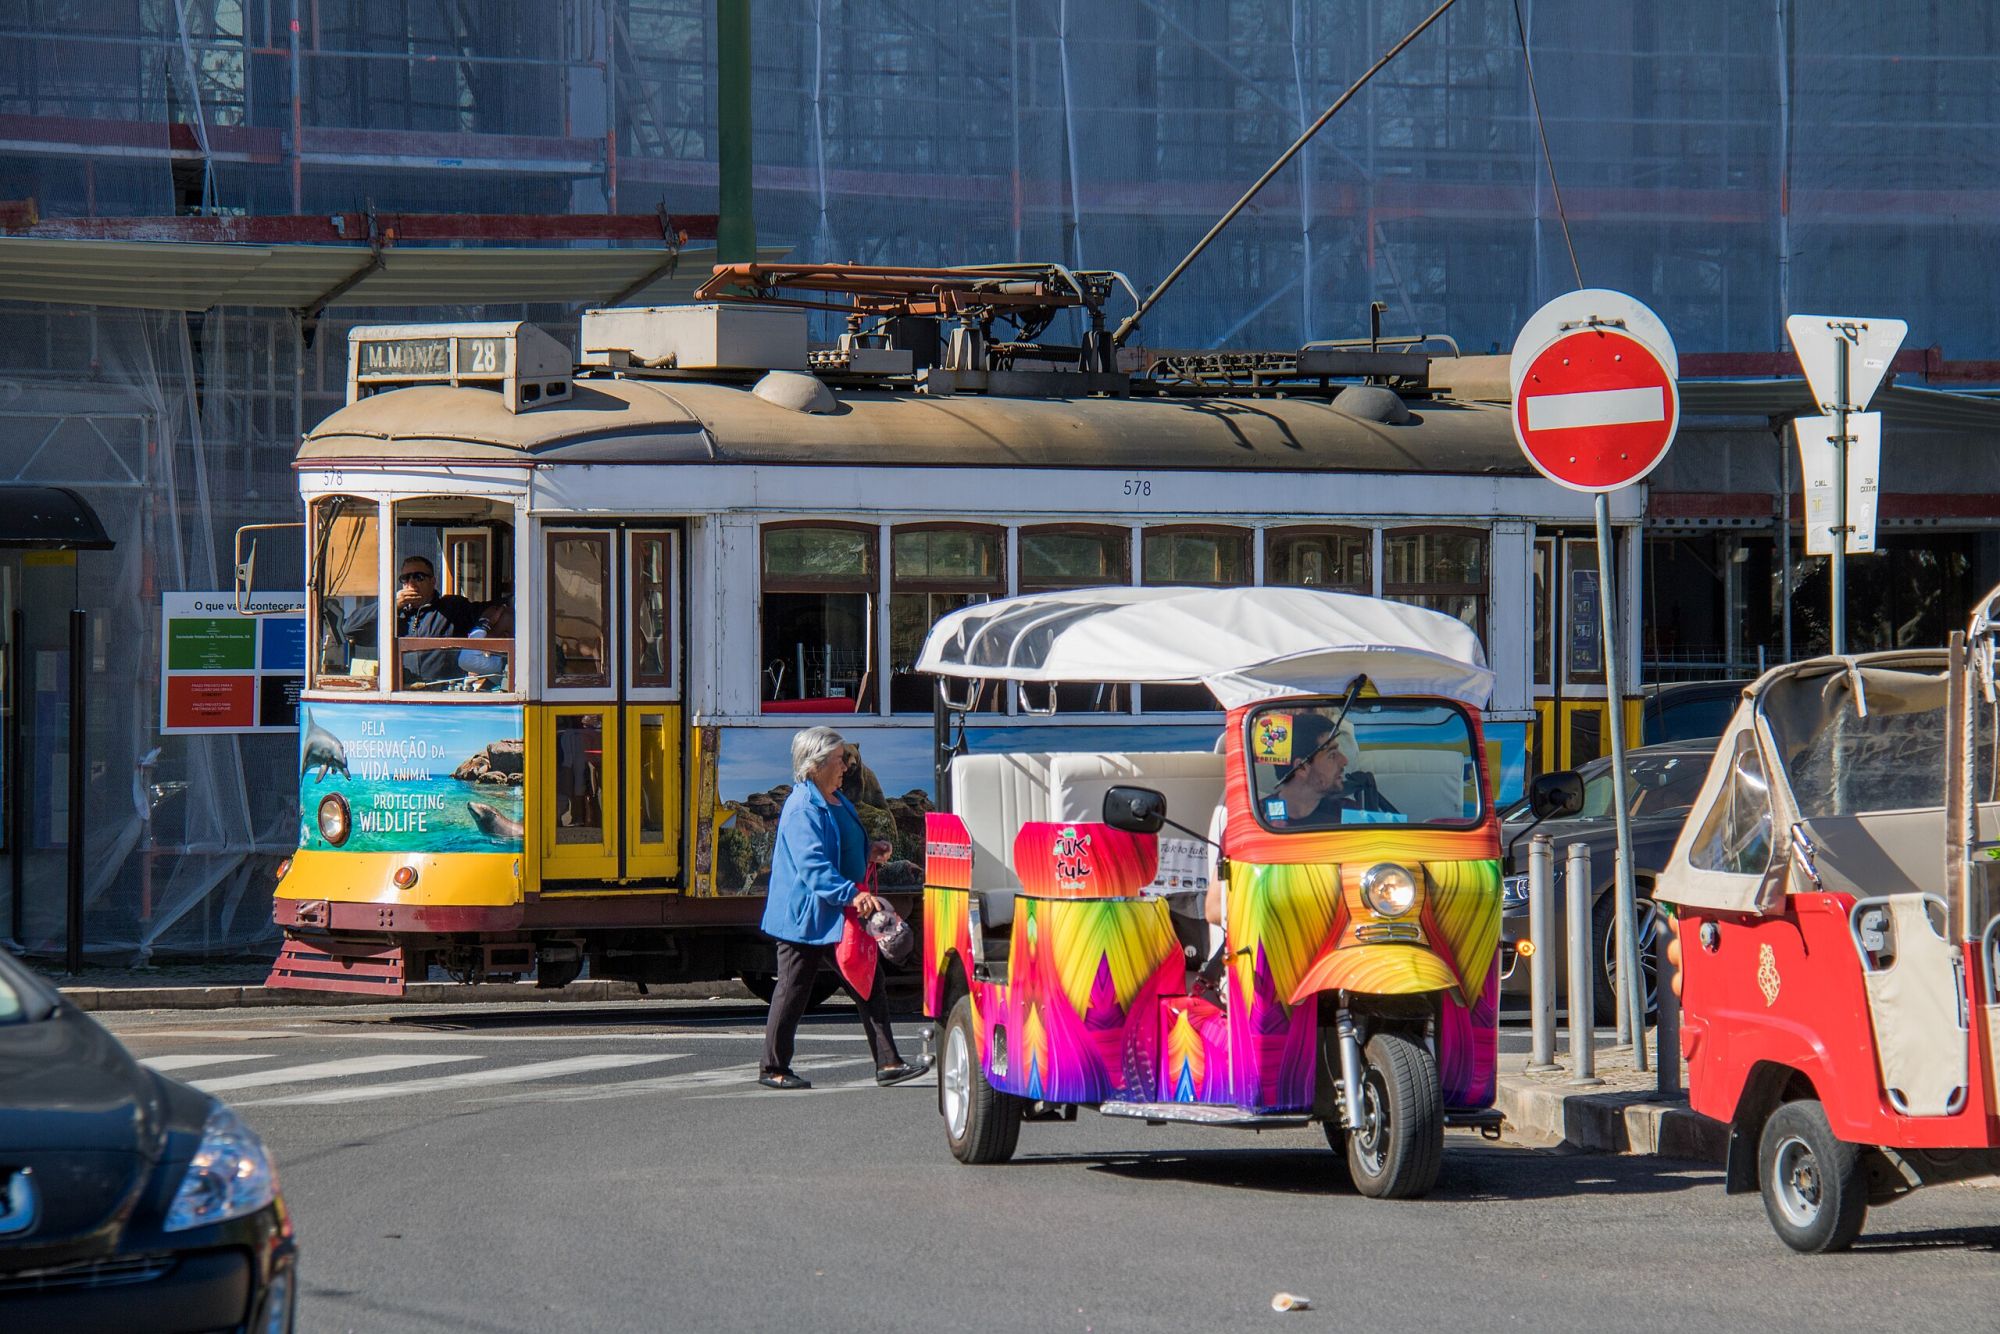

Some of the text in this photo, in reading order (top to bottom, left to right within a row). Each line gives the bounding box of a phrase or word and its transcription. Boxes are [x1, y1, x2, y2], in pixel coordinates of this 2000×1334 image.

[471, 340, 496, 372] 28
[323, 469, 343, 486] 578
[1123, 480, 1151, 496] 578
[194, 601, 203, 611] O
[205, 602, 225, 612] que
[361, 720, 386, 736] PELA
[343, 735, 446, 764] PRESERVAÇÃO DA
[361, 761, 433, 781] VIDA ANIMAL
[373, 793, 445, 810] PROTECTING
[359, 811, 427, 832] WILDLIFE
